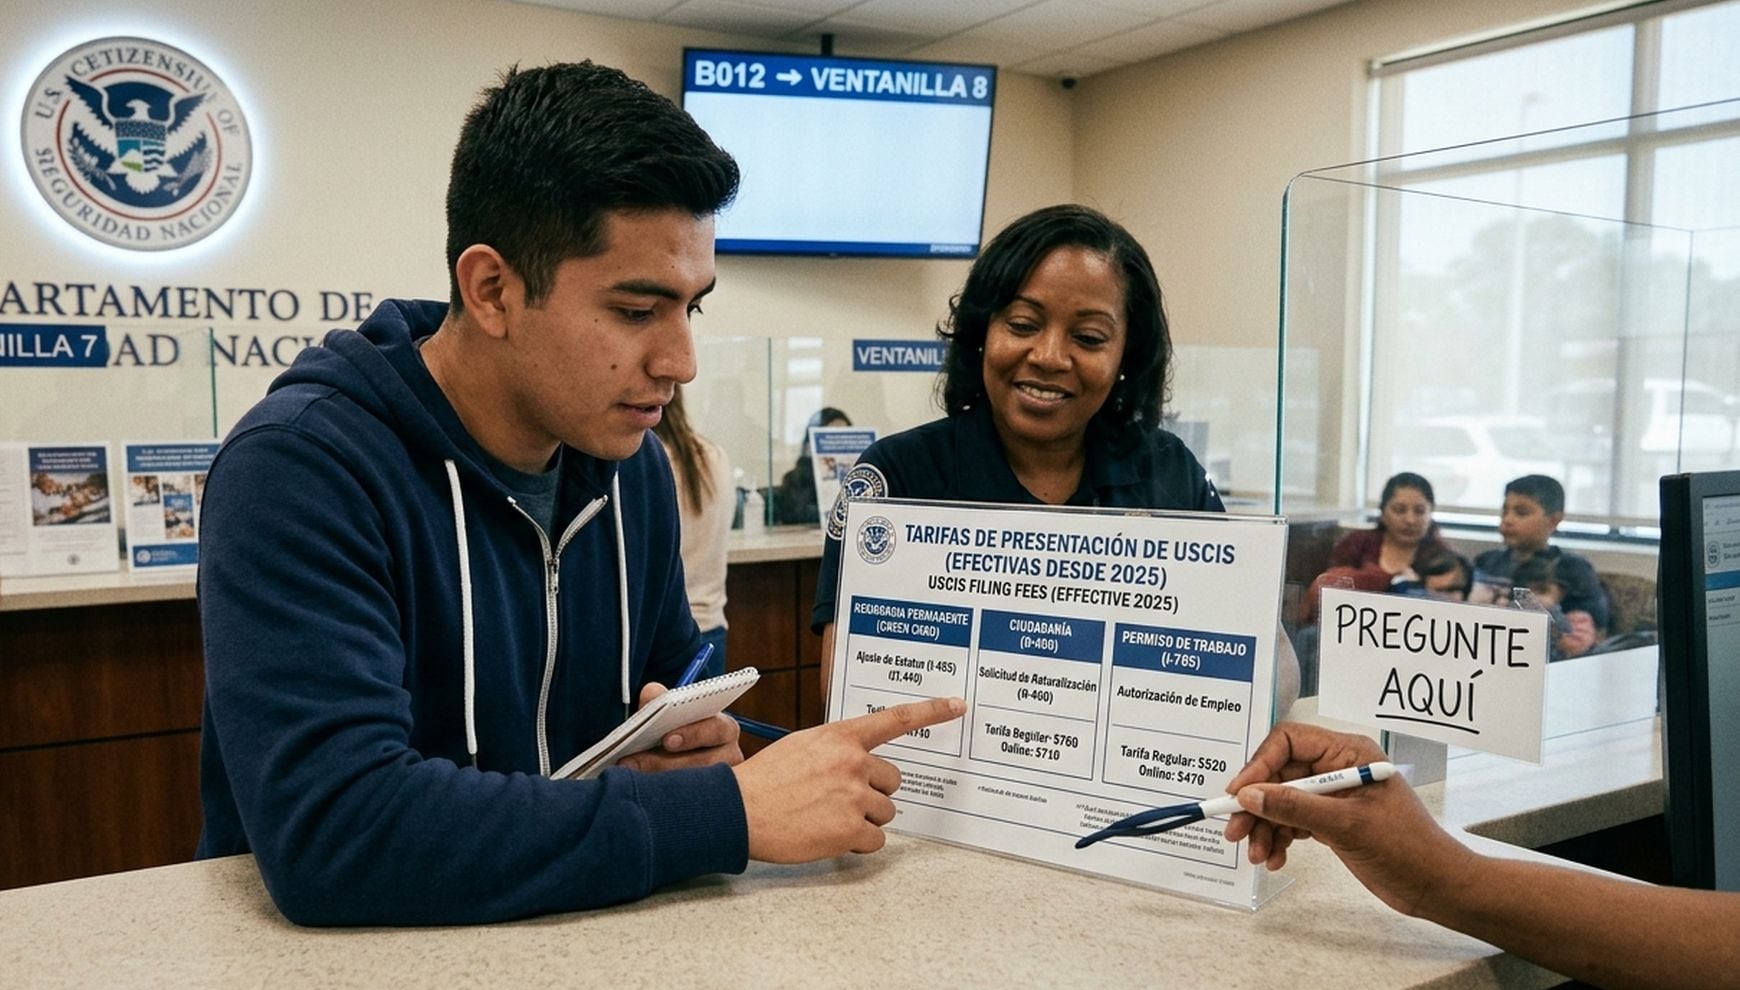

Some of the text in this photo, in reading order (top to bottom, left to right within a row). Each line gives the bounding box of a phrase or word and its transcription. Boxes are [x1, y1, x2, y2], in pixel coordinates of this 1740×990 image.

[694, 59, 988, 98] B012 VENTANILLA 8
[160, 162, 242, 240] NACIONAL
[319, 291, 373, 322] DE
[80, 334, 98, 358] 7
[857, 346, 946, 366] VENTANIL
[905, 524, 971, 546] TARIFAS
[975, 529, 997, 548] DE
[1001, 531, 1137, 558] PRESENTACIÓN
[1143, 539, 1169, 560] DE
[1174, 541, 1235, 564] USCIS
[946, 552, 1167, 590] (EFECTIVAS DESDE 2025)
[928, 575, 1179, 615] USCIS FILING FEES (EFFECTIVE 2025)
[1122, 630, 1247, 656] PERMISO DE TRABAJO
[1336, 604, 1530, 668] PREGUNTE
[1117, 685, 1242, 713] Autorización de Empleo
[1378, 667, 1484, 722] AQUÍ
[1121, 745, 1150, 760] Tarifa
[1152, 750, 1196, 768] Regular:
